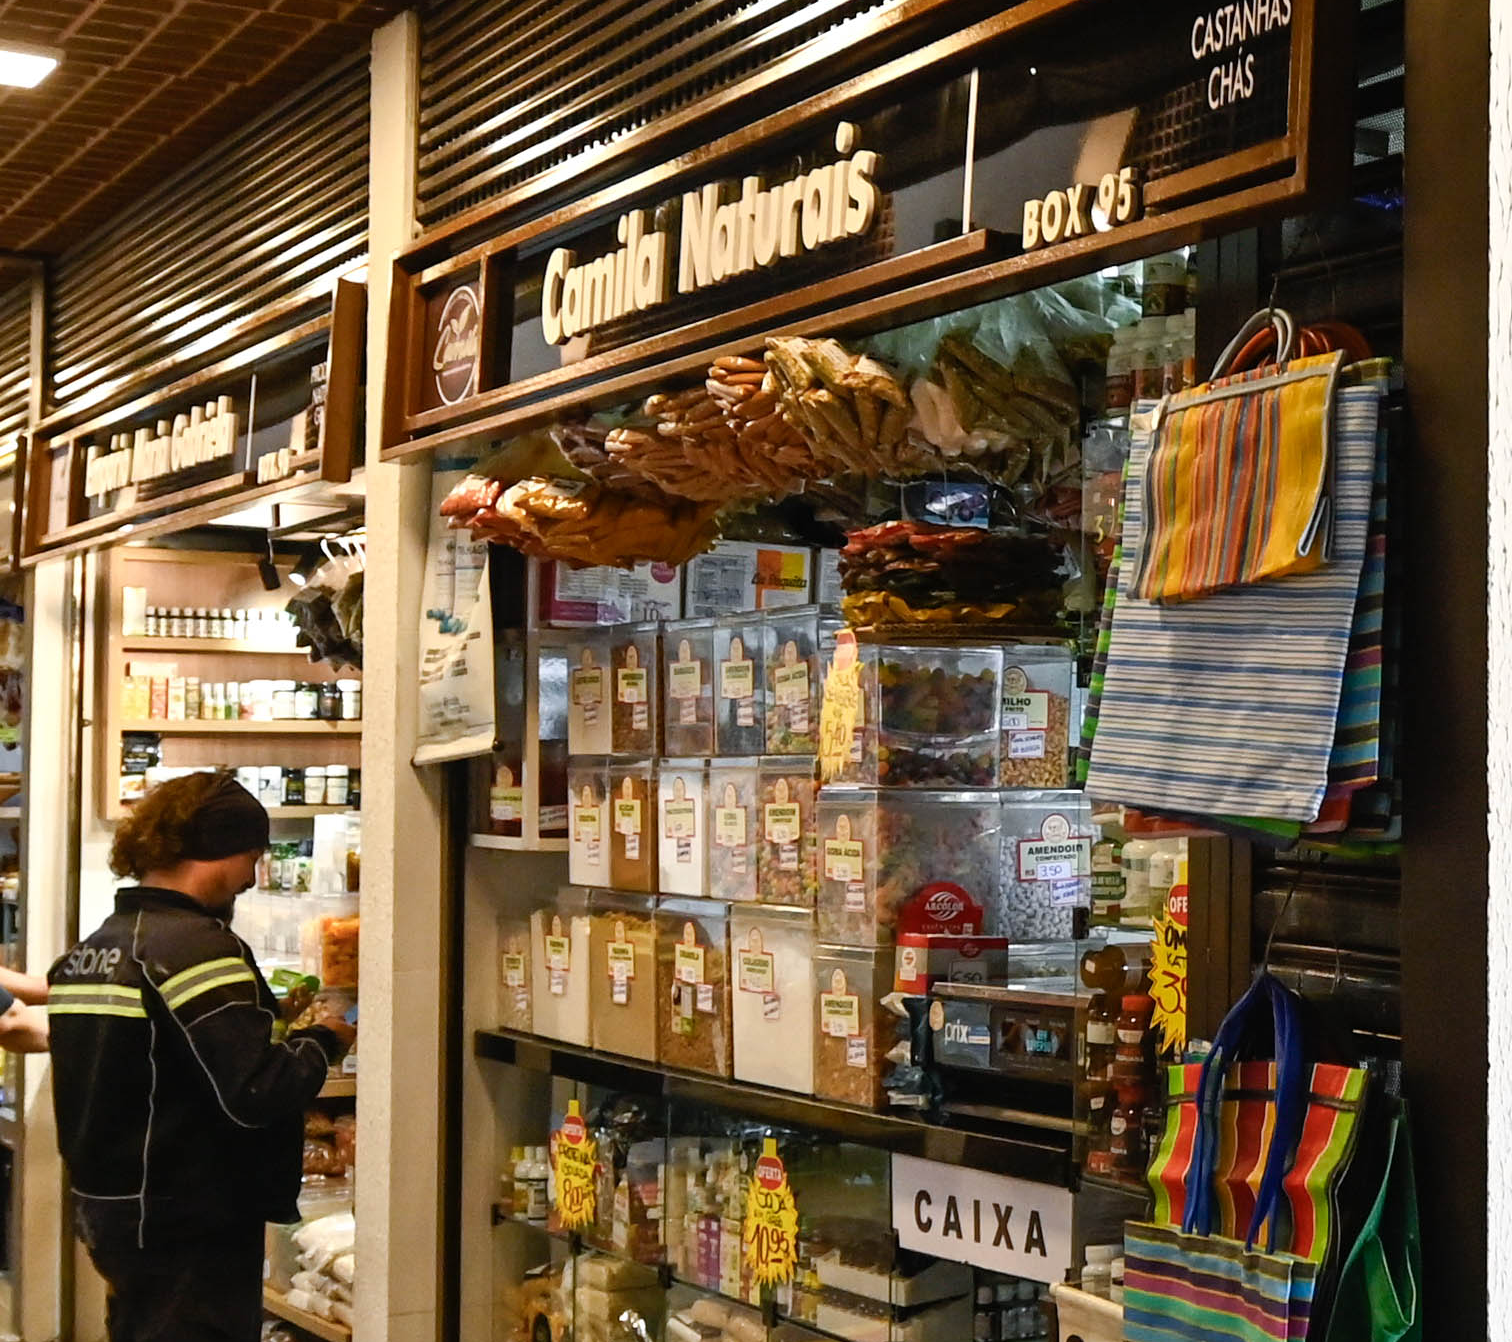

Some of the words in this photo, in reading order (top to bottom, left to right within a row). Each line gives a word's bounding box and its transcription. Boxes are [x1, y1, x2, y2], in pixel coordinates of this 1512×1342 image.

[1207, 55, 1256, 112] CHÁS
[541, 209, 670, 346] Camila
[678, 120, 882, 295] Naturais
[1021, 184, 1084, 250] BOX
[1092, 166, 1140, 231] 95
[925, 900, 964, 913] ARCOLOR
[913, 1189, 1048, 1259] CAIXA
